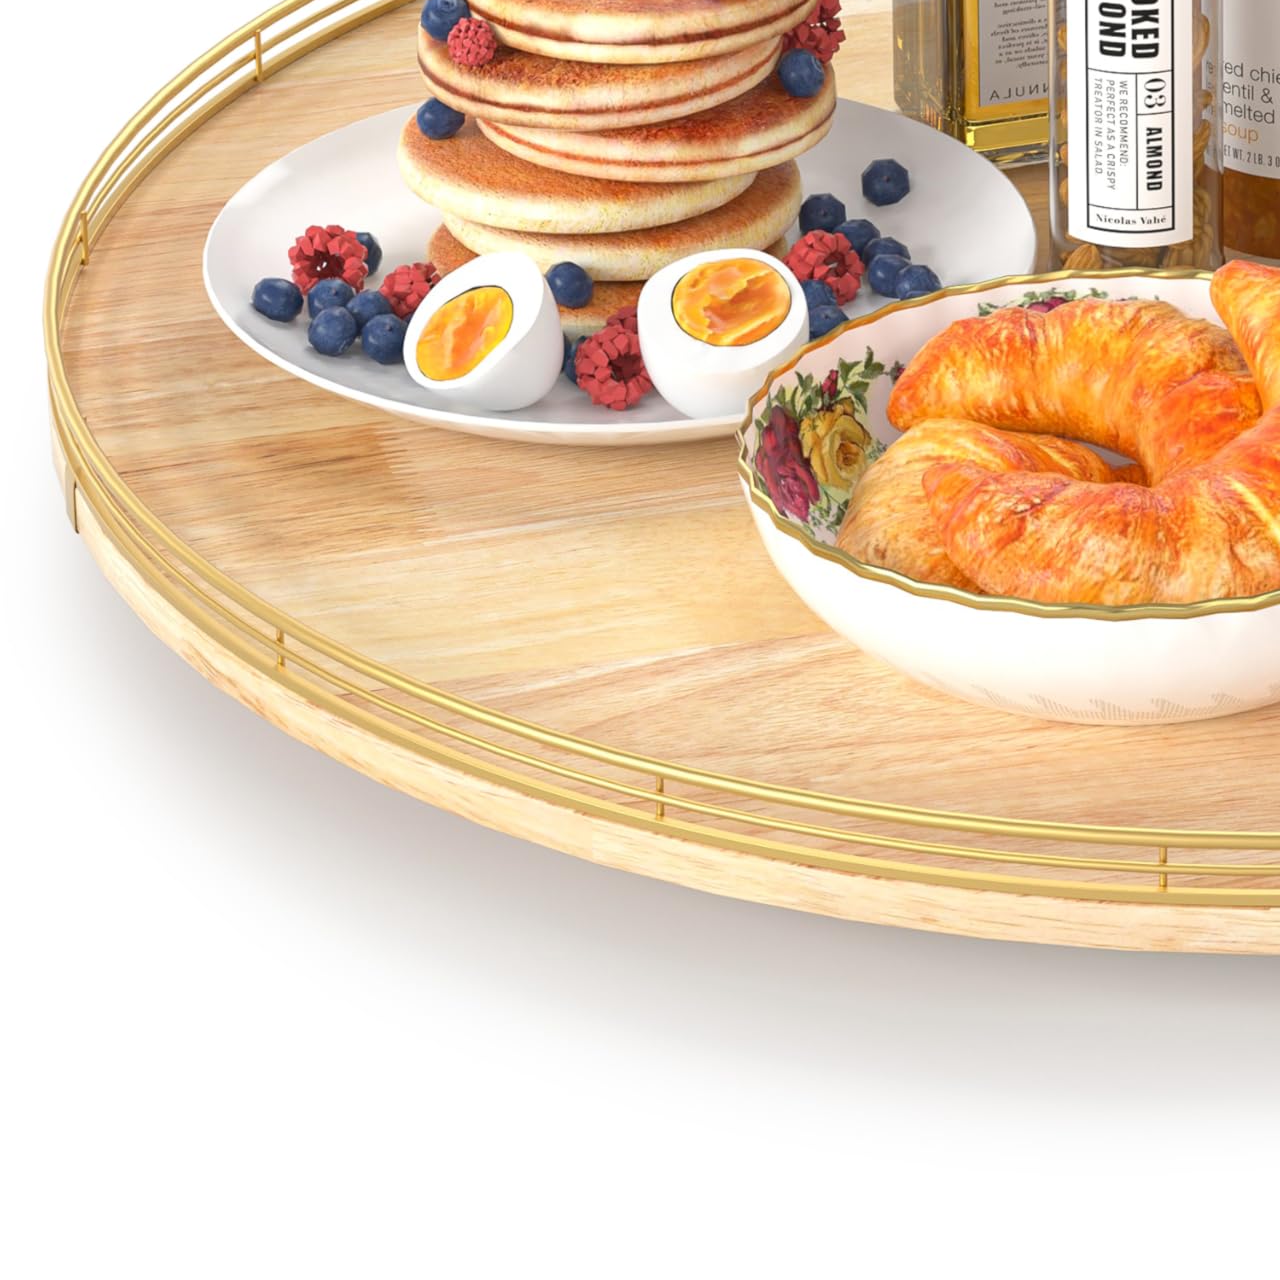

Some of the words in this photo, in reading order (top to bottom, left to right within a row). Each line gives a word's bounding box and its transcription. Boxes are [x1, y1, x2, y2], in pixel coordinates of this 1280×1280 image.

[1224, 62, 1244, 77] ed
[1119, 80, 1128, 96] WE
[1143, 77, 1167, 109] 03
[1222, 81, 1254, 100] entil
[1260, 87, 1273, 104] &
[1106, 79, 1116, 126] PERFECT
[1094, 126, 1103, 137] IN
[1106, 127, 1116, 141] AS
[1145, 127, 1163, 191] ALMOND
[1106, 152, 1116, 191] CRISPY
[1096, 213, 1136, 225] Nicolas
